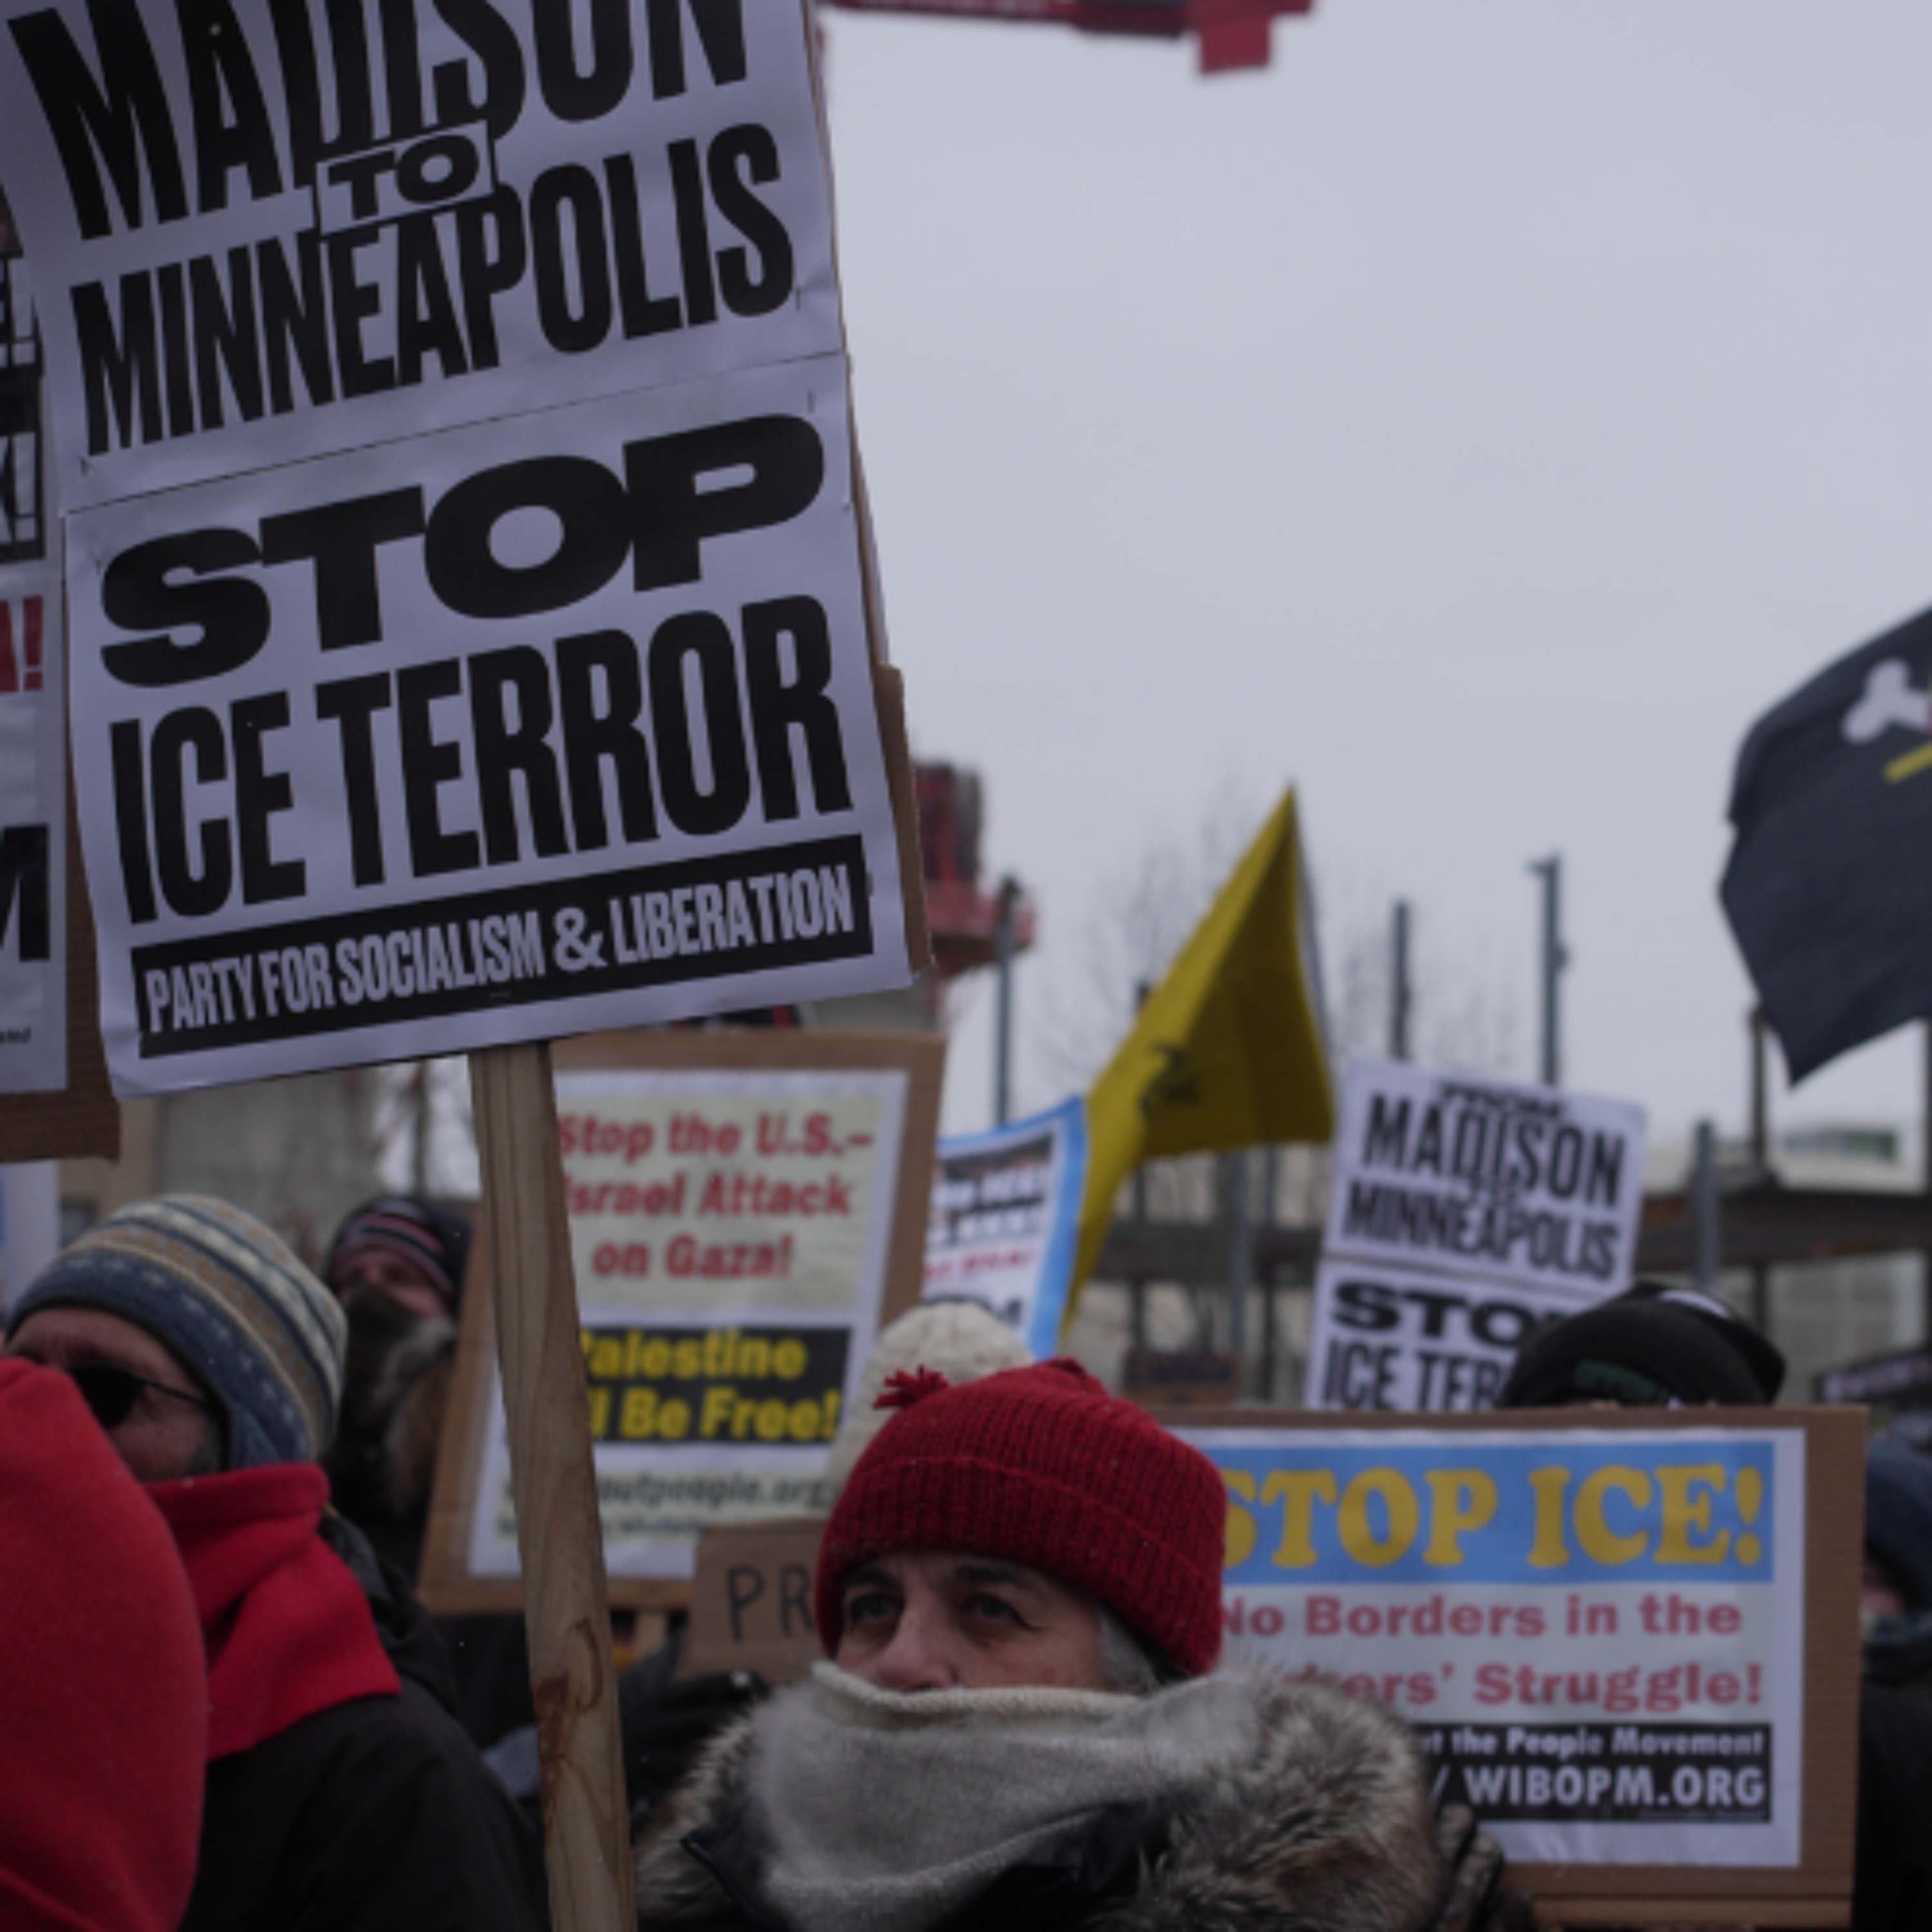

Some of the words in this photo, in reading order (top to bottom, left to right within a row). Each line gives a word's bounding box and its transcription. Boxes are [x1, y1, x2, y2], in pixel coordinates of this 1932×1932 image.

[327, 134, 480, 221] TO
[70, 122, 795, 456] MINNEAPOLIS
[100, 413, 824, 688] STOP
[109, 690, 306, 925] ICE
[314, 594, 853, 889] TERROR
[144, 952, 256, 1034] PARTY
[260, 945, 336, 1018] FOR
[337, 909, 545, 1006] SOCIALISM
[553, 906, 608, 969] &
[609, 864, 855, 965] LIBERATION
[558, 1113, 654, 1164] Stop
[667, 1113, 740, 1155] the
[1361, 1094, 1625, 1208] MADISON
[564, 1173, 685, 1216] srael
[697, 1171, 853, 1215] Attack
[1342, 1177, 1620, 1282] MINNEAPOLIS
[592, 1240, 649, 1278] on
[664, 1233, 795, 1278] Gaza!
[1332, 1279, 1571, 1349] STO
[1322, 1336, 1400, 1410] ICE
[620, 1387, 690, 1439] Be
[701, 1387, 842, 1440] Free!
[1527, 1465, 1763, 1567] ICE!
[1304, 1594, 1544, 1638] Borders
[1567, 1594, 1618, 1634] in
[1640, 1594, 1743, 1635] the
[1475, 1663, 1761, 1714] Struggle!
[1451, 1725, 1499, 1756] the
[1506, 1727, 1605, 1763] People
[1610, 1727, 1764, 1756] Movement
[1462, 1765, 1766, 1808] WIBOPM.ORG
